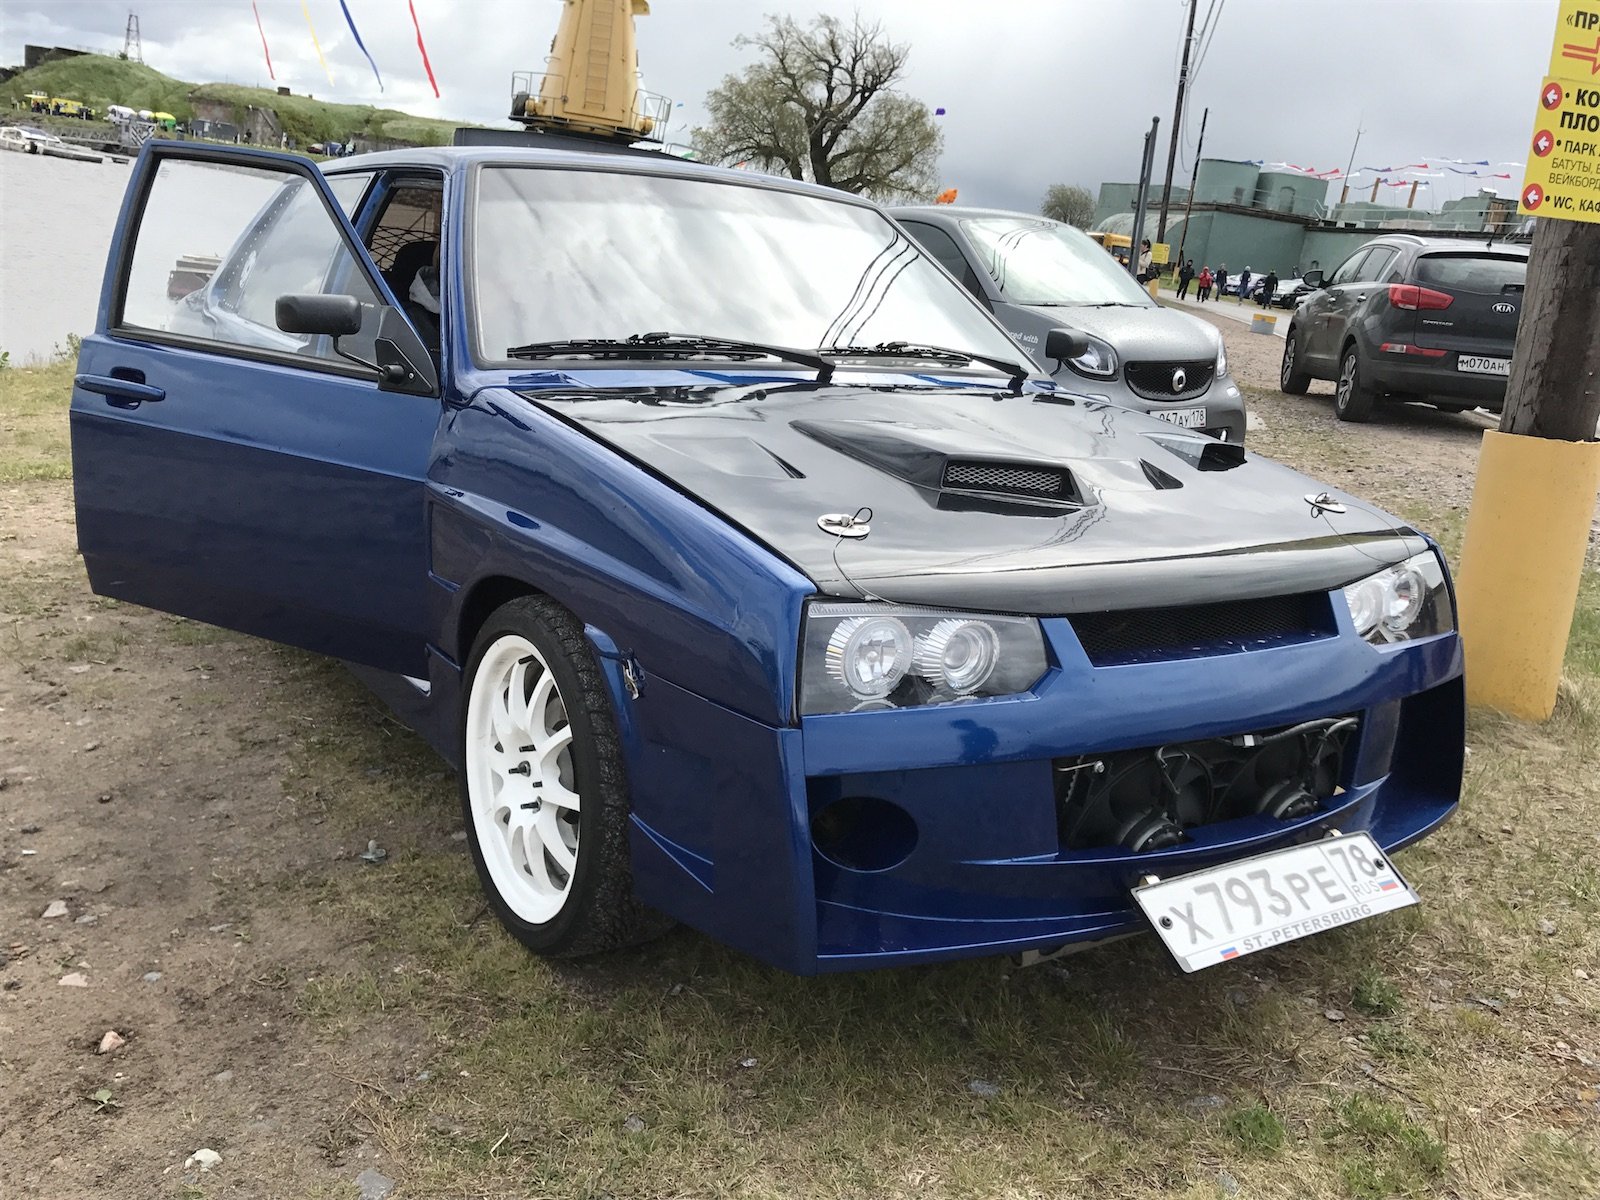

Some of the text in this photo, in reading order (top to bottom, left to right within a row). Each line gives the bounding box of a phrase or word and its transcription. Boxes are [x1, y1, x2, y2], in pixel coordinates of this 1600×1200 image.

[1566, 10, 1600, 31] «ПР
[1564, 140, 1597, 156] ПАРК
[1551, 157, 1593, 174] БАТУТЫ,
[1554, 195, 1575, 212] WC,
[1496, 304, 1511, 313] KIA
[1191, 410, 1204, 422] 178
[1329, 844, 1377, 882] 78
[1352, 880, 1381, 897] RUS
[1243, 903, 1372, 952] ST.-PETERSBURG
